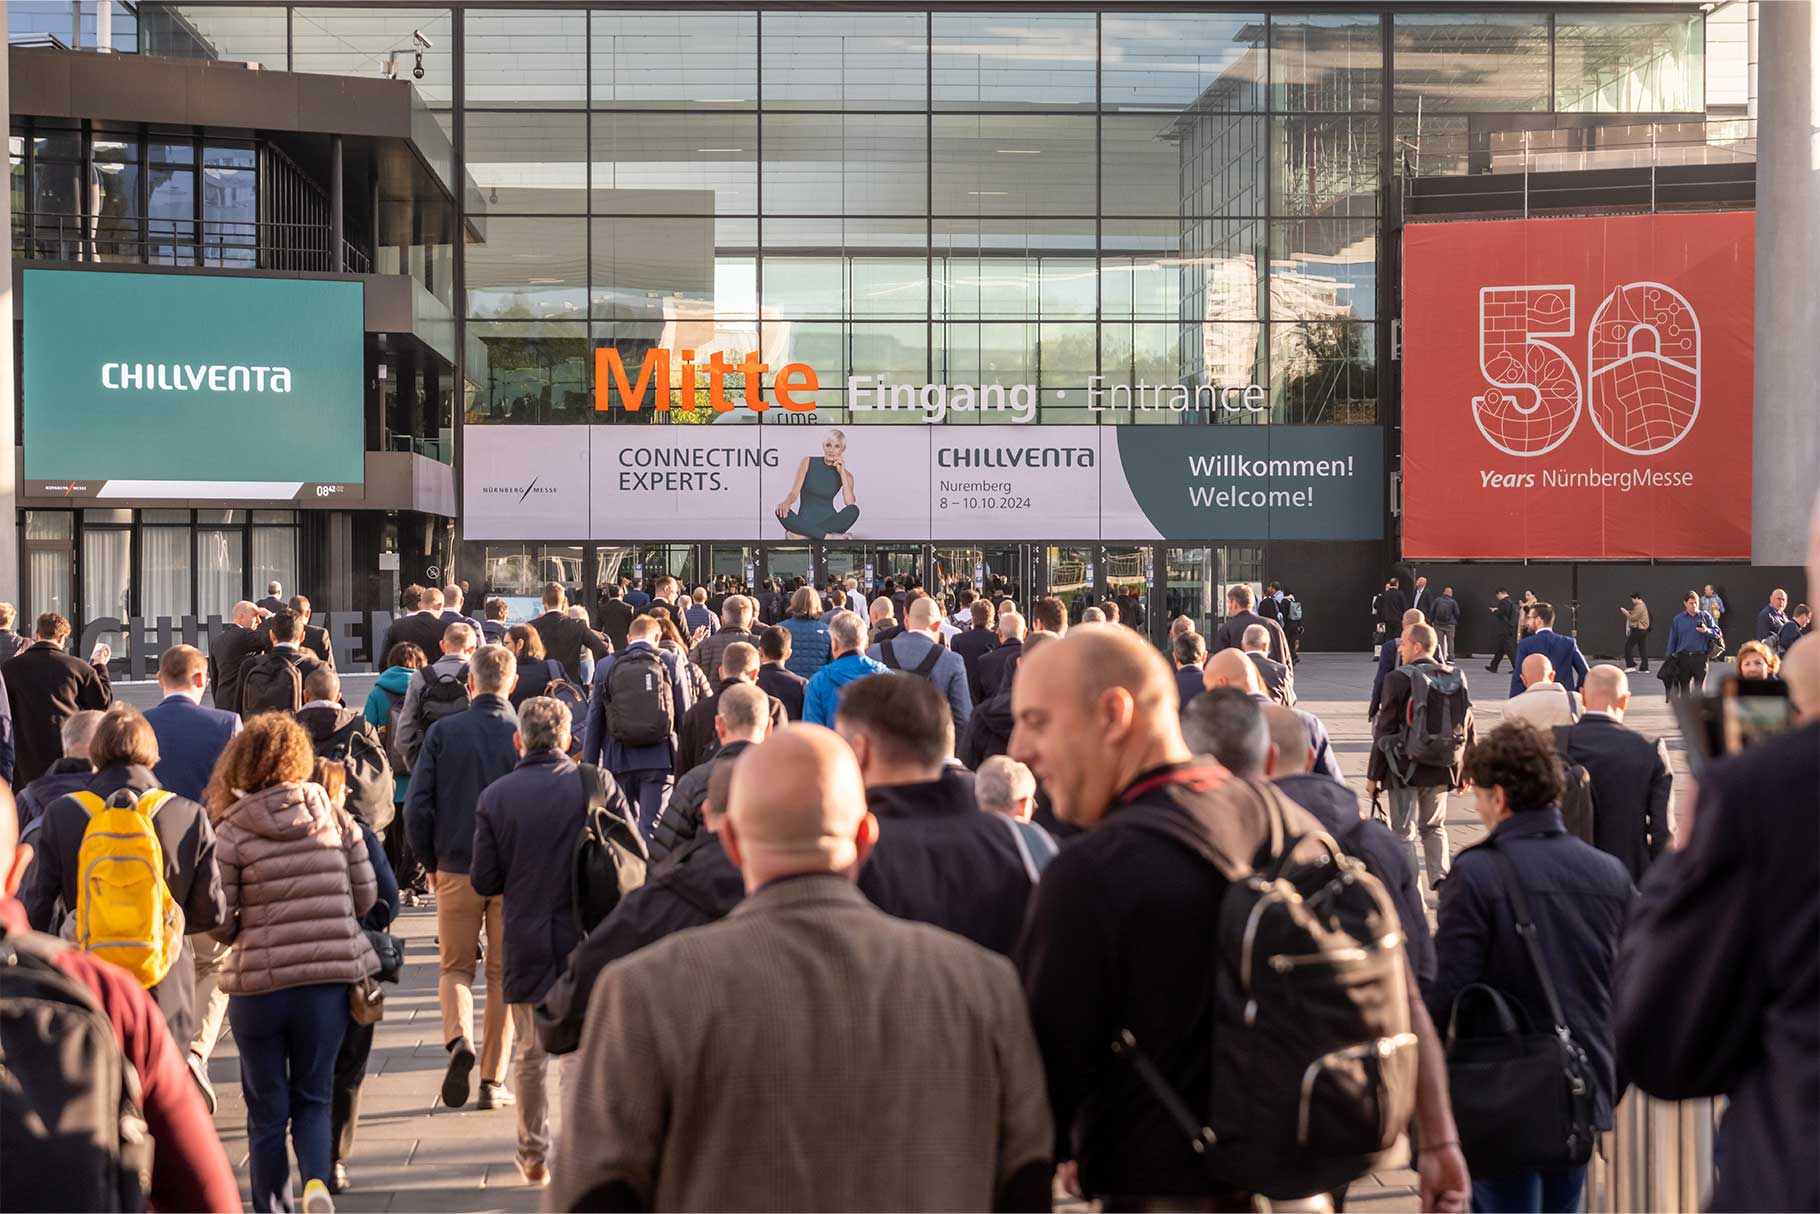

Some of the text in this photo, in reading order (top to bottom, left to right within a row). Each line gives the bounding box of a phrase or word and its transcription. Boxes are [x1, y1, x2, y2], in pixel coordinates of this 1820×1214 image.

[1472, 281, 1701, 456] 50
[595, 347, 819, 412] Mitte
[848, 374, 1037, 423] Eingang
[1087, 375, 1265, 412] Entrance
[619, 448, 779, 467] CONNECTING
[1189, 455, 1353, 476] Willkommen!
[619, 472, 728, 491] EXPERTS.
[940, 480, 1012, 494] Nuremberg
[1480, 468, 1693, 492] Years NürnbergMesse
[940, 497, 948, 509] 8
[964, 497, 1031, 509] 10.10.2024
[1189, 485, 1313, 507] Welcome!
